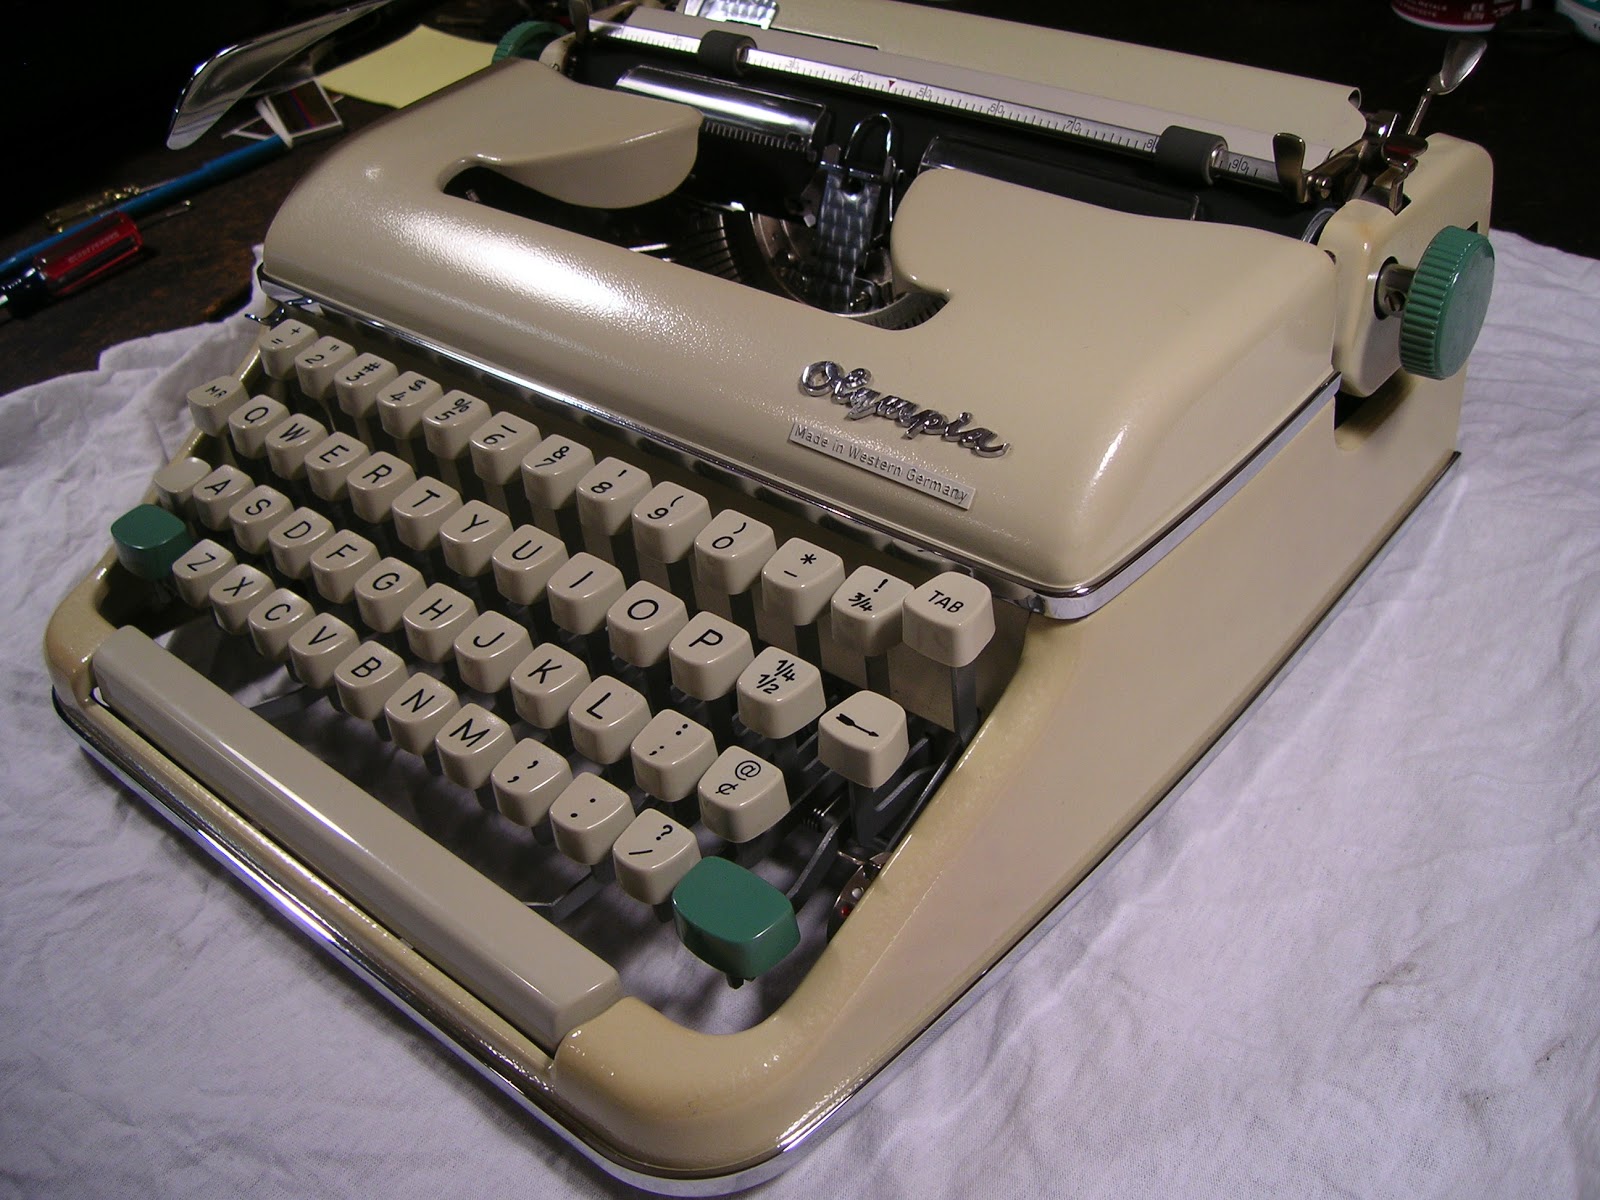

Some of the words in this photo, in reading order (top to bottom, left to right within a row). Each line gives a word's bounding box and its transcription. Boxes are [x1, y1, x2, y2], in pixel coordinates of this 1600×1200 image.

[786, 59, 799, 70] 30
[850, 72, 864, 84] 40
[917, 87, 933, 100] 50
[988, 102, 1004, 114] 60
[1065, 119, 1082, 132] 70
[1231, 158, 1251, 172] 90
[305, 354, 325, 365] 2
[346, 372, 366, 382] 3
[390, 391, 406, 402] 4
[244, 406, 269, 424] Q
[434, 411, 456, 421] 5
[802, 360, 1010, 458] Olympia
[279, 422, 310, 442] W
[483, 433, 506, 445] 6
[320, 444, 349, 463] E
[535, 458, 557, 467] 7
[795, 424, 829, 449] Made
[832, 439, 845, 455] in
[848, 445, 902, 477] Western
[906, 467, 969, 504] Germany
[363, 464, 392, 484] R
[204, 479, 232, 496] A
[590, 481, 613, 494] 8
[244, 498, 272, 516] S
[412, 489, 441, 508] T
[461, 513, 490, 533] Y
[647, 507, 669, 520] 9
[282, 520, 312, 539] D
[325, 543, 358, 559] F
[511, 539, 543, 561] U
[187, 553, 216, 571] Z
[222, 576, 254, 597] X
[372, 572, 401, 591] G
[419, 598, 453, 622] H
[928, 589, 965, 613] TAB
[264, 603, 291, 622] C
[308, 625, 338, 646] V
[472, 632, 505, 648] J
[688, 628, 724, 648] P
[350, 656, 382, 678] B
[527, 658, 563, 685] K
[400, 688, 436, 713] N
[585, 692, 612, 720] L
[448, 717, 491, 748] M
